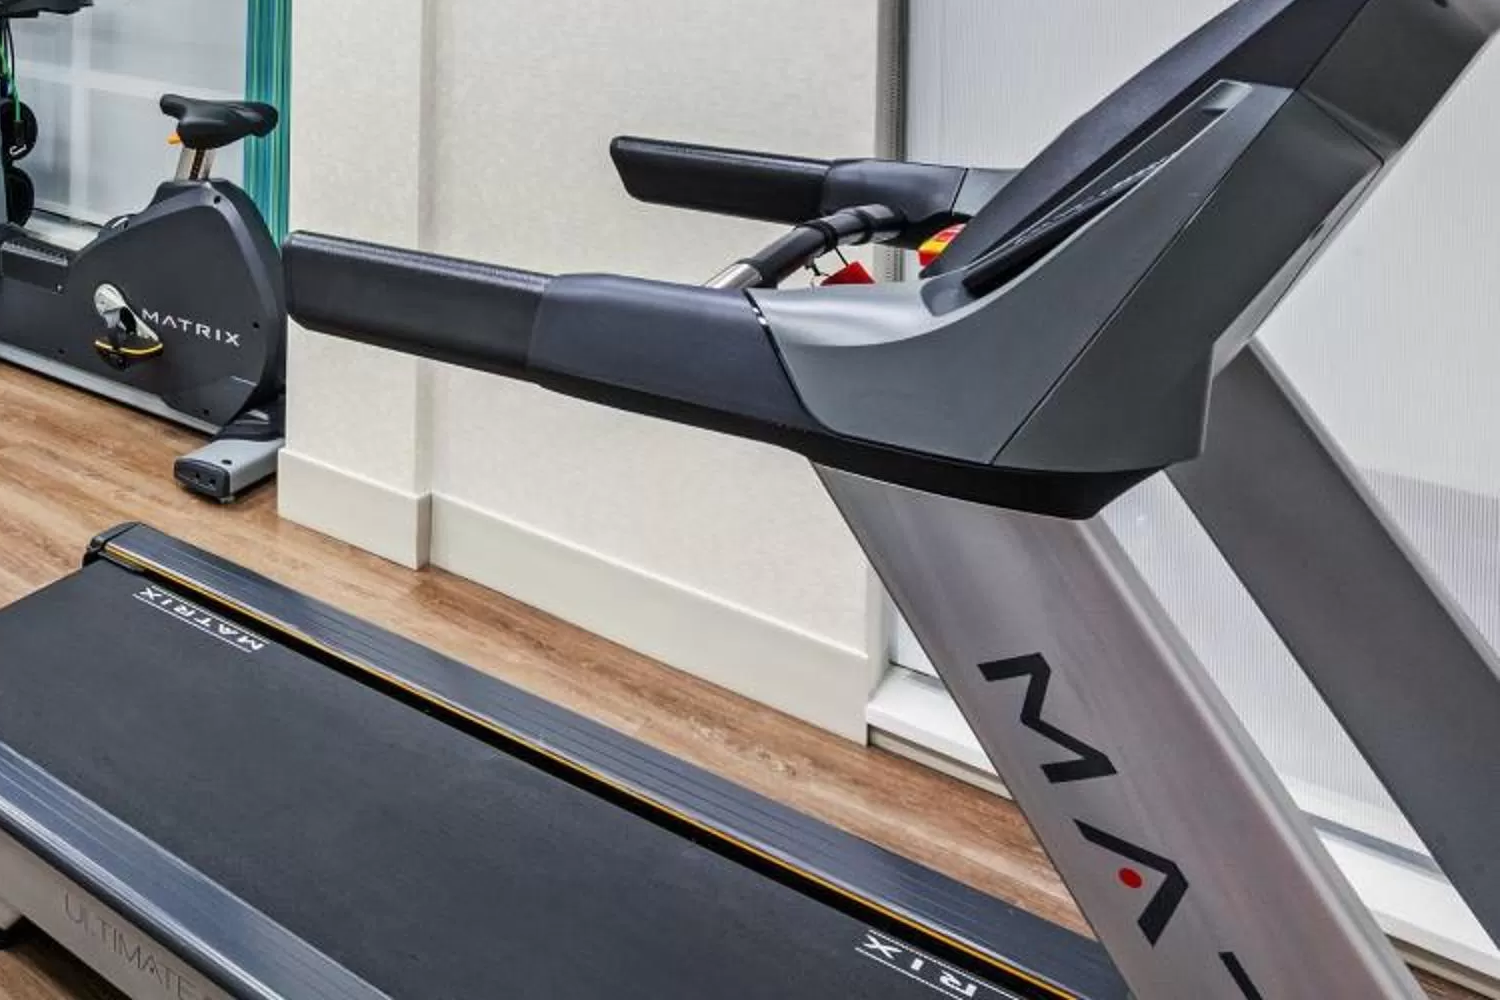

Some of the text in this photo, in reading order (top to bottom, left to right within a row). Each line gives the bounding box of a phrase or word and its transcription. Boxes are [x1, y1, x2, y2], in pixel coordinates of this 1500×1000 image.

[141, 308, 241, 348] MATRIX
[140, 587, 264, 650] MATRIX
[863, 934, 978, 998] RIX
